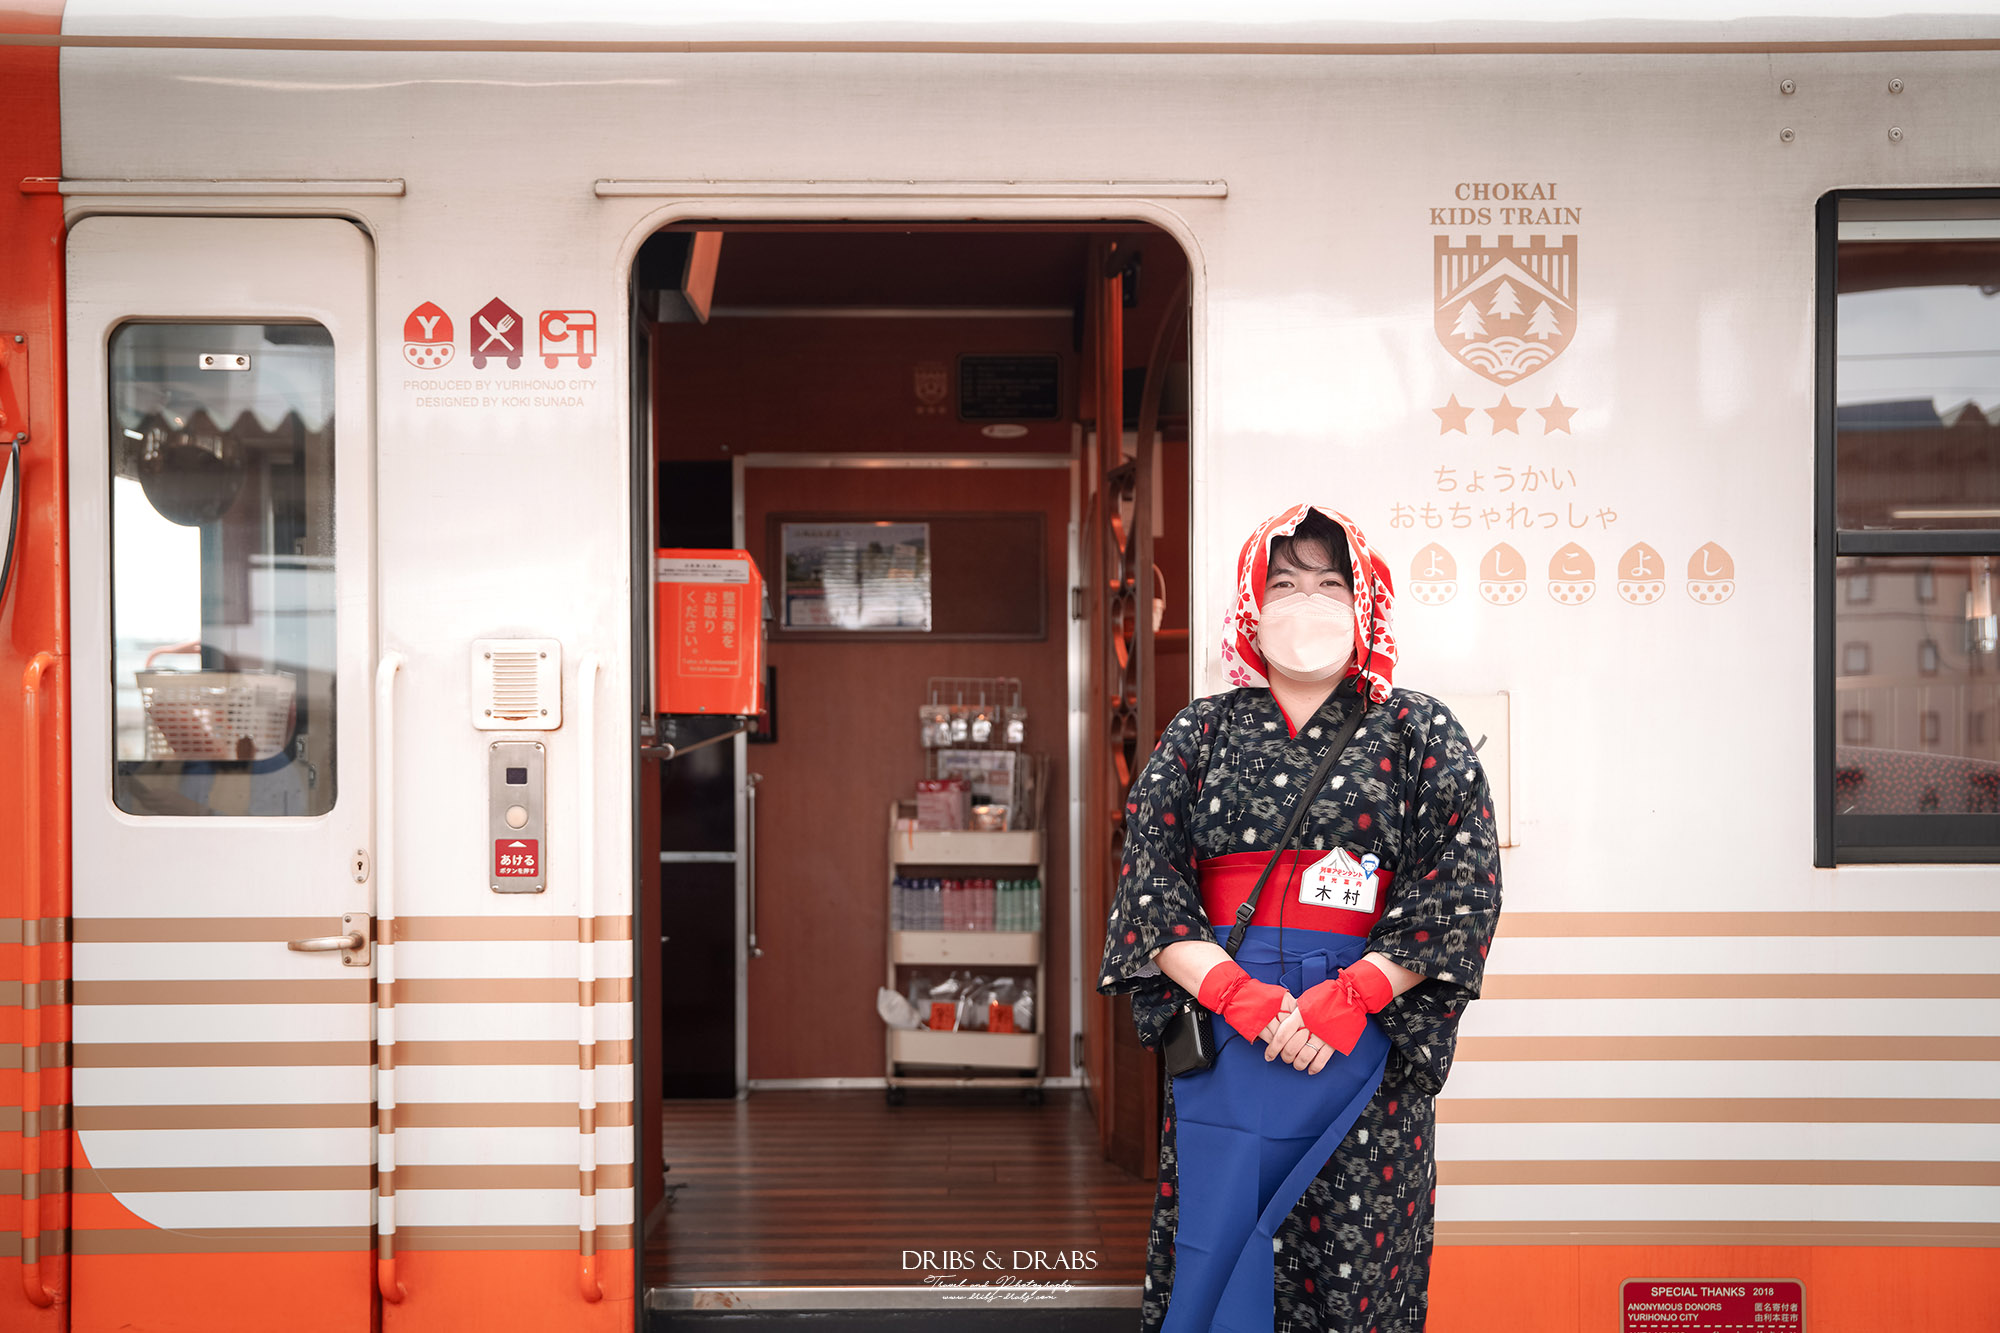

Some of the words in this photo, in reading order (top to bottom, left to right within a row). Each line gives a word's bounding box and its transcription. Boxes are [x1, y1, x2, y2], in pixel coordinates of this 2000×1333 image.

[1454, 182, 1558, 201] CHOKAI
[1429, 206, 1492, 226] KIDS
[1500, 206, 1582, 226] TRAIN
[416, 315, 441, 340] Y
[403, 380, 472, 391] PRODUCED
[475, 380, 491, 391] BY
[495, 380, 566, 391] YURIHONJO
[569, 380, 597, 391] CITY
[416, 397, 479, 408] DESIGNED
[482, 397, 498, 408] BY
[502, 397, 531, 408] KOKI
[534, 397, 585, 408] SUNADA
[1433, 465, 1578, 494] ちょうかい
[1389, 502, 1619, 531] おもちゃれっしゃ
[704, 592, 718, 634] お取り
[722, 591, 736, 648] 整理券を
[500, 854, 535, 866] あける
[1315, 885, 1361, 906] 木村
[1651, 1287, 1698, 1297] SPECIAL
[1700, 1287, 1746, 1297] THANKS
[1753, 1287, 1774, 1296] 2018
[1628, 1303, 1683, 1311] ANONYMOUS
[1684, 1303, 1722, 1311] DONORS
[1754, 1302, 1798, 1312] 匿名寄付者
[1628, 1313, 1677, 1321] YURIHONJO
[1679, 1313, 1699, 1321] CITY
[1754, 1313, 1798, 1322] 由利本荘市
